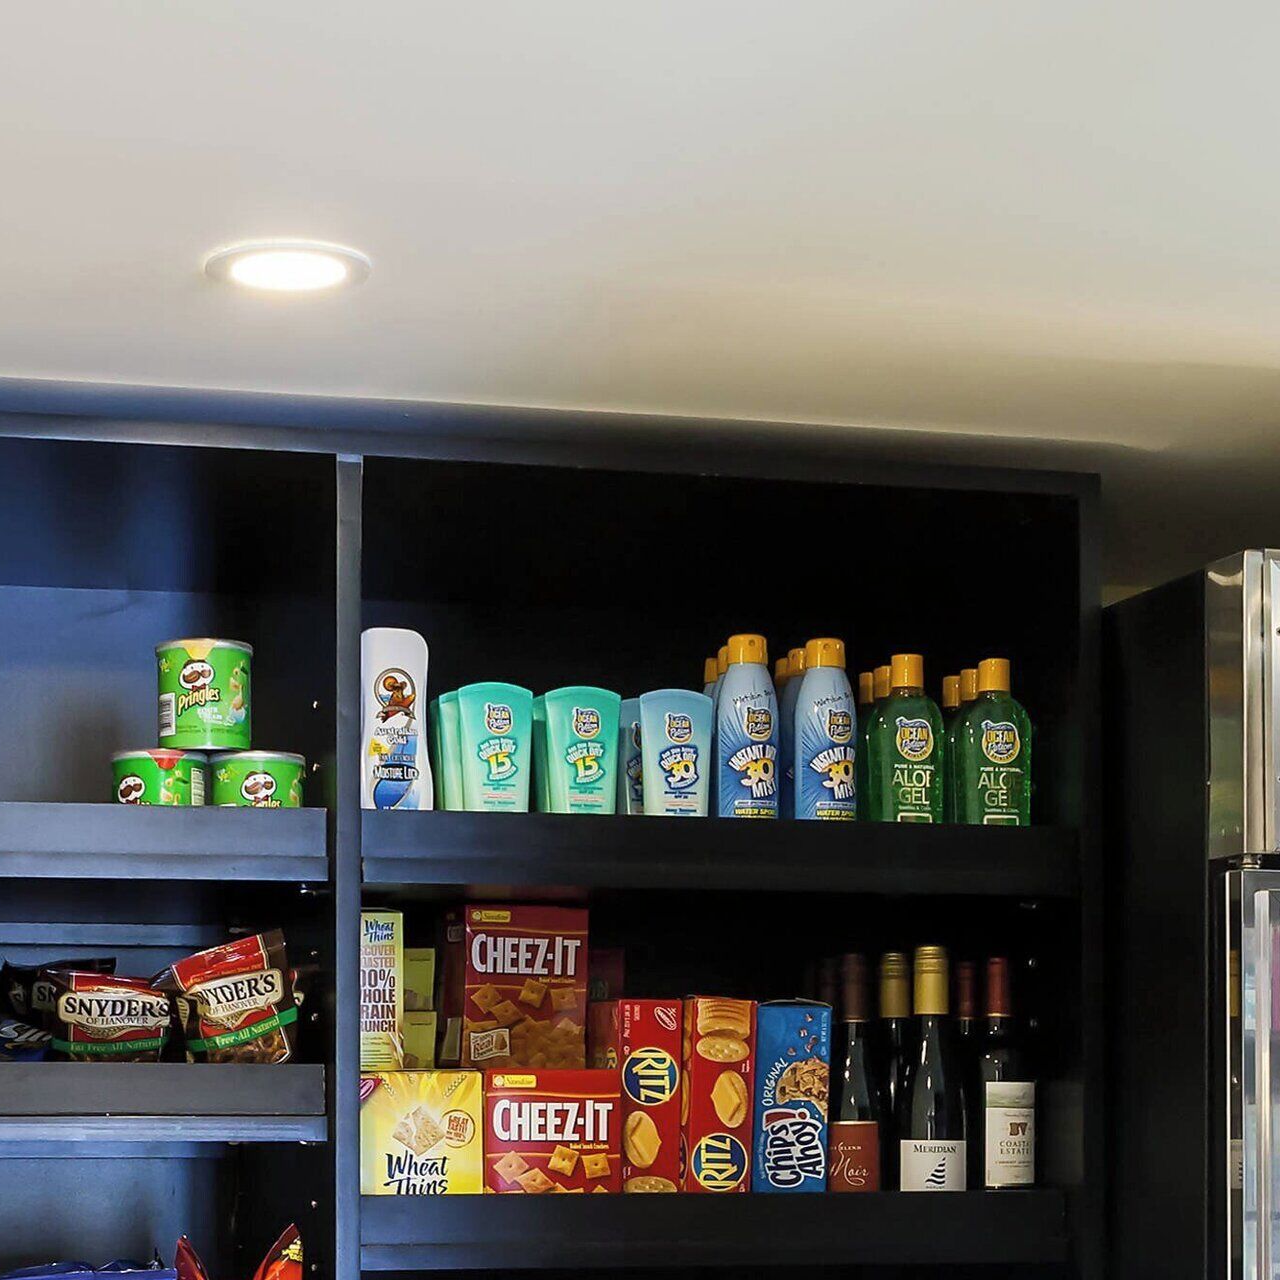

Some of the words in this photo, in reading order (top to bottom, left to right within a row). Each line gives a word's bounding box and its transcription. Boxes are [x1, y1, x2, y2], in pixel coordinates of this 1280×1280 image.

[177, 684, 220, 716] Pringles
[374, 726, 418, 737] Australian
[901, 728, 929, 740] OCEAN
[987, 730, 1015, 742] OCEAN
[902, 739, 926, 752] Potion
[988, 741, 1013, 753] Potion
[489, 753, 512, 776] 15
[575, 756, 599, 778] 15
[728, 744, 764, 771] INSTANT
[809, 746, 845, 773] INSTANT
[667, 760, 696, 780] 30
[740, 758, 775, 787] 30
[822, 760, 855, 788] 30
[899, 788, 930, 804] GEL
[984, 790, 1008, 806] GE
[364, 919, 395, 934] Wheat
[363, 931, 395, 943] Thins
[471, 932, 582, 976] CHEEZ-IT
[360, 969, 396, 988] 00%
[198, 974, 276, 1006] NYDER'S
[361, 988, 396, 1003] HOLE
[64, 996, 170, 1018] SNYDER'S
[220, 997, 260, 1013] HANOVER
[360, 1004, 397, 1019] RAIN
[86, 1017, 96, 1025] OF
[100, 1016, 149, 1026] HANOVER
[360, 1020, 397, 1033] RUNCH
[216, 1035, 235, 1049] Free
[238, 1028, 250, 1040] All
[251, 1015, 279, 1034] Natural
[126, 1038, 162, 1050] Natural
[631, 1051, 671, 1103] RITZ
[762, 1057, 789, 1107] ORIGINAL
[492, 1099, 614, 1142] CHEEZ-IT
[767, 1123, 800, 1188] Chips
[913, 1144, 957, 1153] MERIDIAN
[385, 1150, 450, 1178] Wheat
[699, 1136, 738, 1188] RITZ
[383, 1176, 449, 1194] Thins
